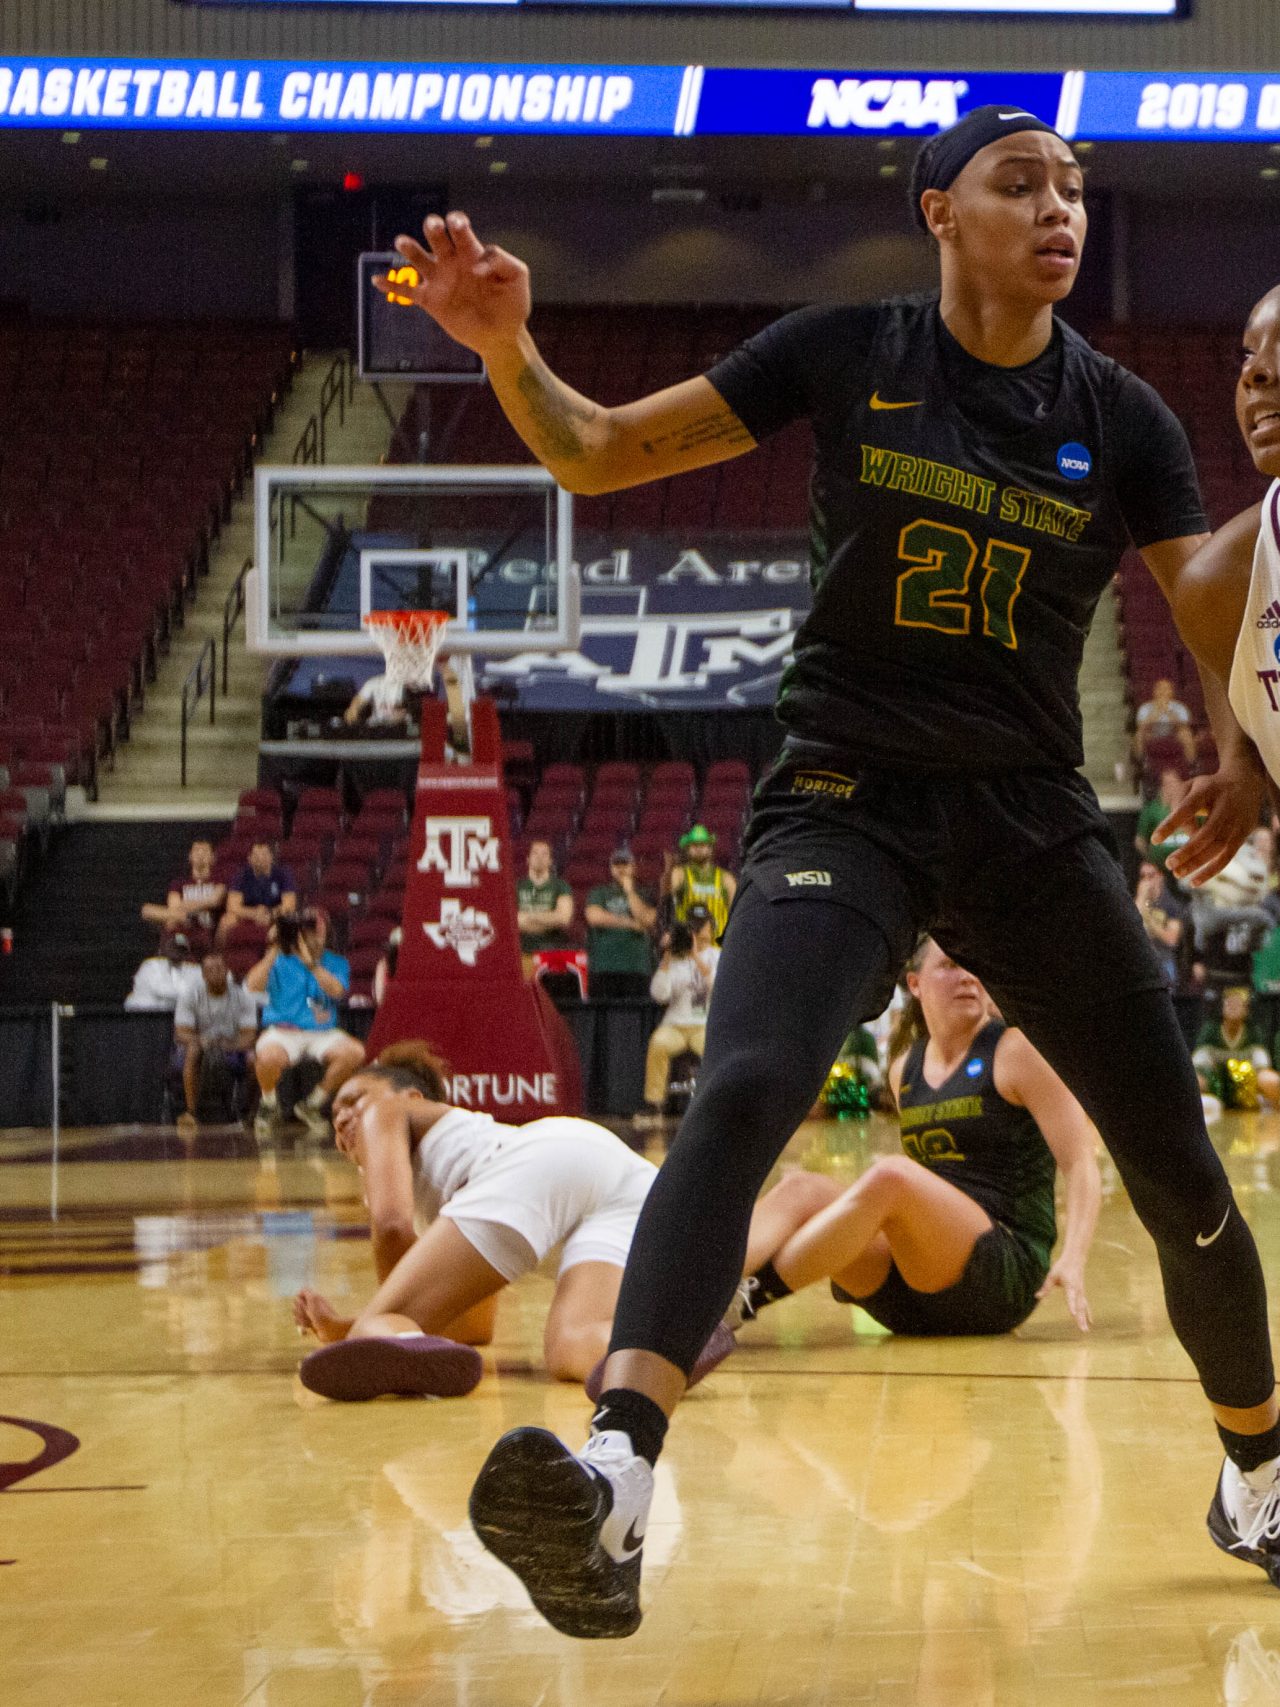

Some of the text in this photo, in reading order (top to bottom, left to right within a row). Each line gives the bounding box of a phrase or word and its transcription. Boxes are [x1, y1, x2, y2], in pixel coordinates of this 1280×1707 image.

[279, 71, 633, 122] CHAMPIONSHIP
[1136, 82, 1248, 129] 2019
[1061, 457, 1089, 472] NCAA
[860, 445, 1092, 542] WRIGHT STATE
[895, 518, 1031, 650] 21
[784, 870, 833, 887] WSU
